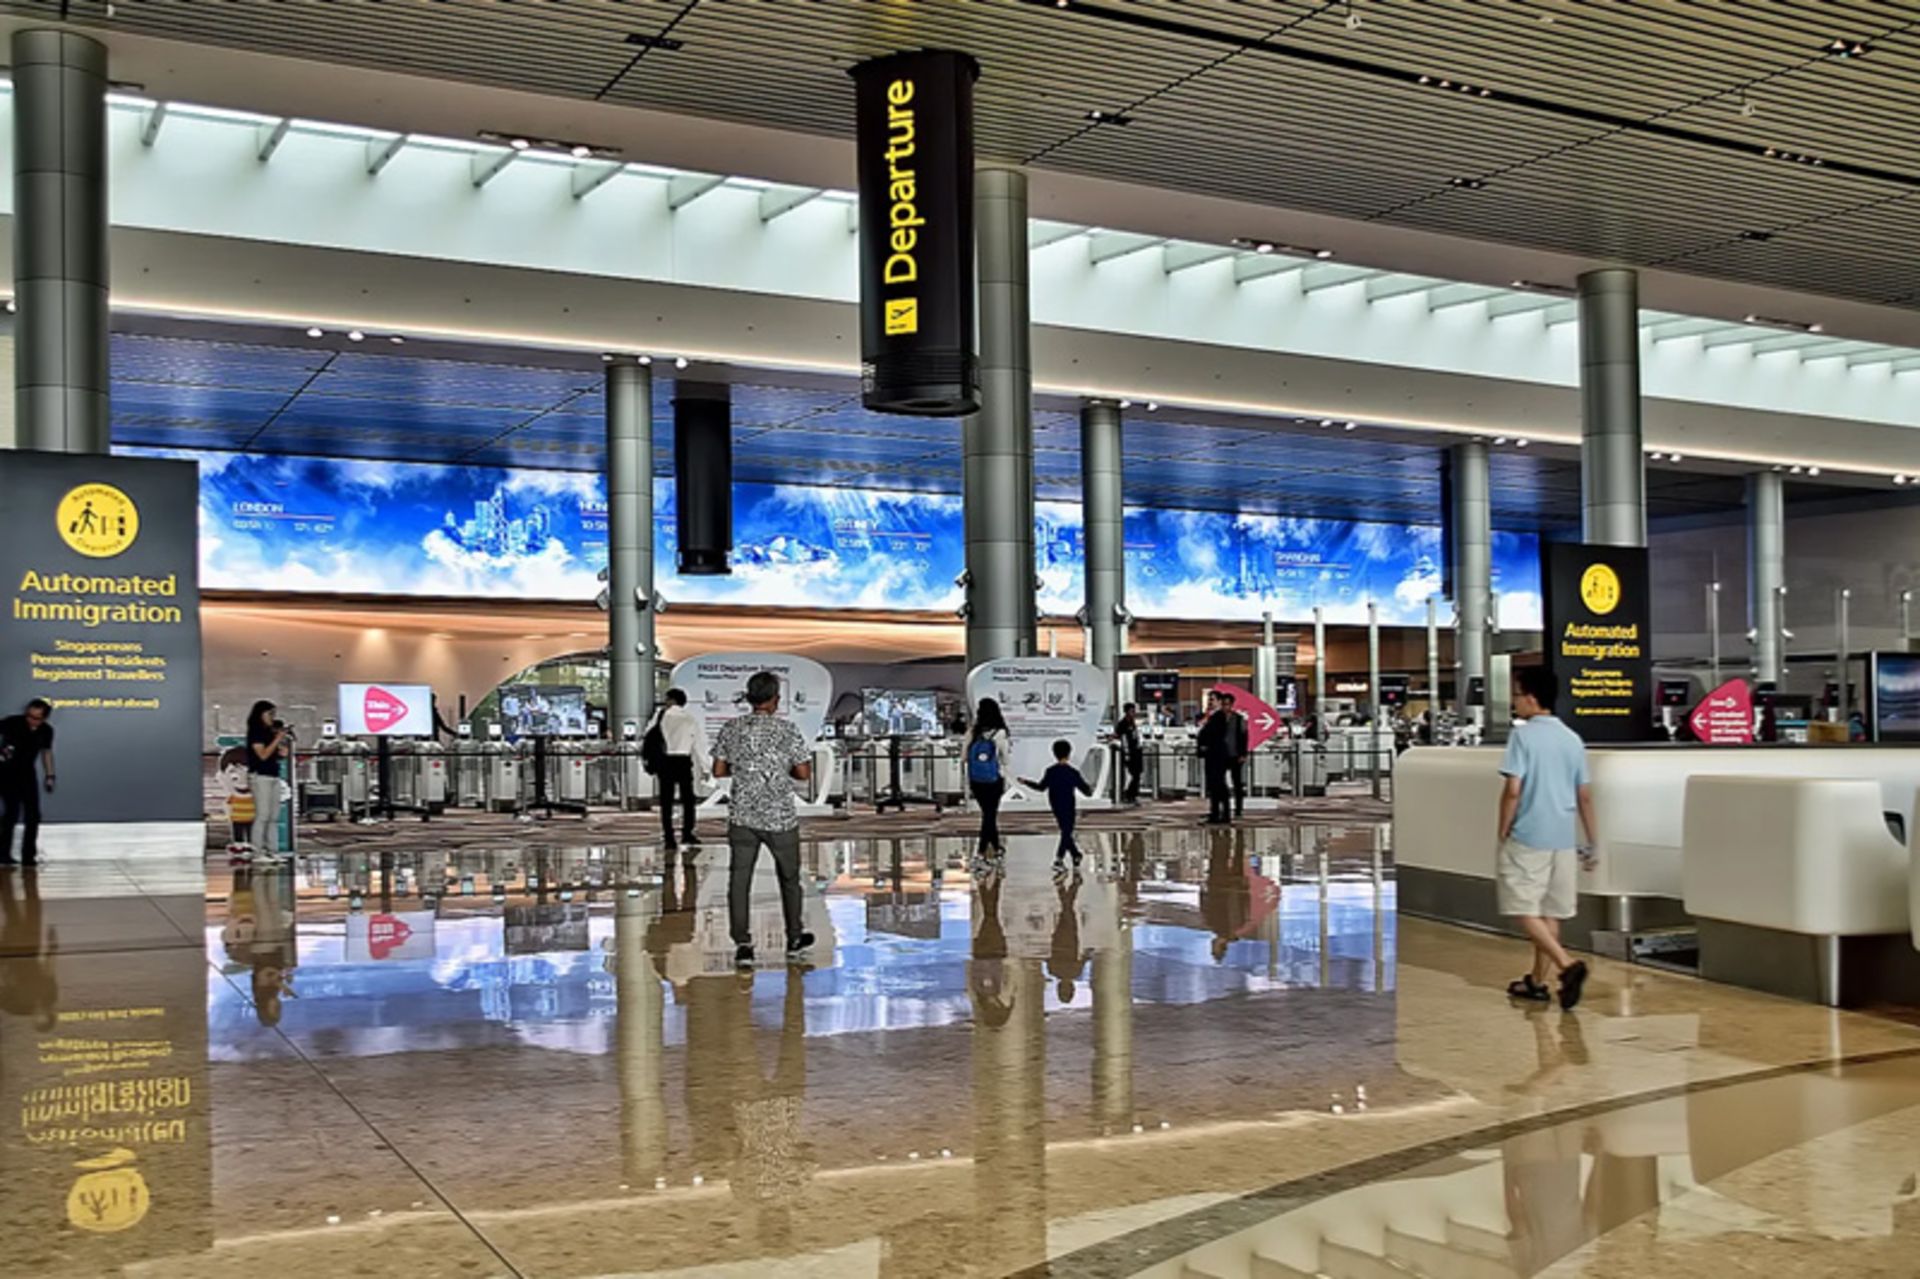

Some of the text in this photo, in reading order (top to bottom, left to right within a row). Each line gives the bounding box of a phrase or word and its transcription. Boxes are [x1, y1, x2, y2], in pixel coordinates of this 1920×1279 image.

[884, 79, 925, 284] Departure
[232, 501, 284, 513] LONDON
[580, 501, 608, 512] HON
[20, 570, 177, 597] Automated
[13, 597, 182, 628] Immigration
[1564, 622, 1638, 640] Automated
[54, 640, 144, 654] Singaporeans
[1561, 640, 1641, 661] Immigration
[31, 653, 167, 667] Permanent Residents
[32, 667, 166, 682] Registered Travellers
